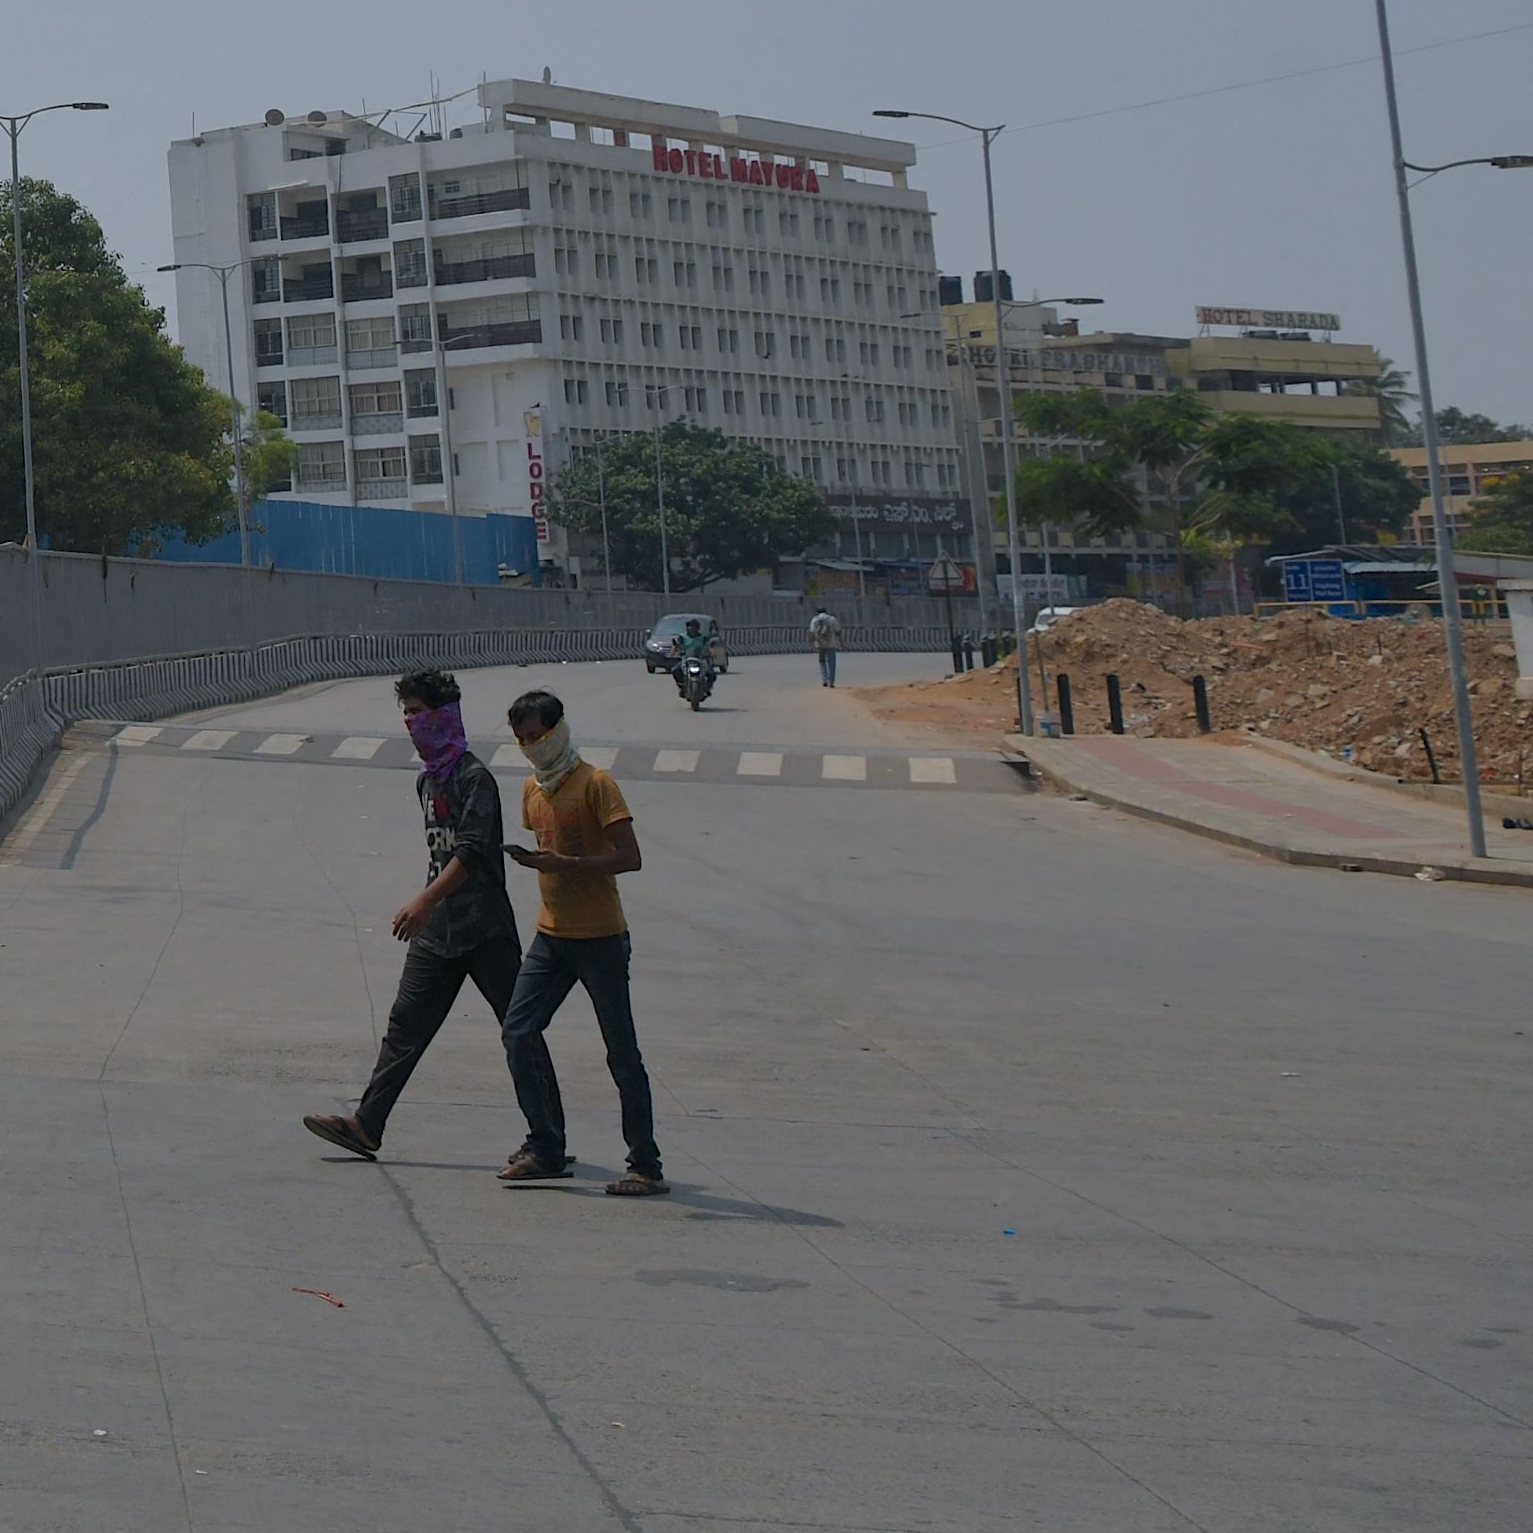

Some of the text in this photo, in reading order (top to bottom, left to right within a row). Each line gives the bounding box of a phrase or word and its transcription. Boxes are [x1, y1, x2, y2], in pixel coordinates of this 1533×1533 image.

[652, 146, 820, 193] HOTEL MAYURA
[1201, 308, 1340, 330] HOTEL SHARADA
[969, 345, 1029, 366] HOEL
[528, 443, 547, 540] LODGE
[1286, 574, 1309, 590] 11
